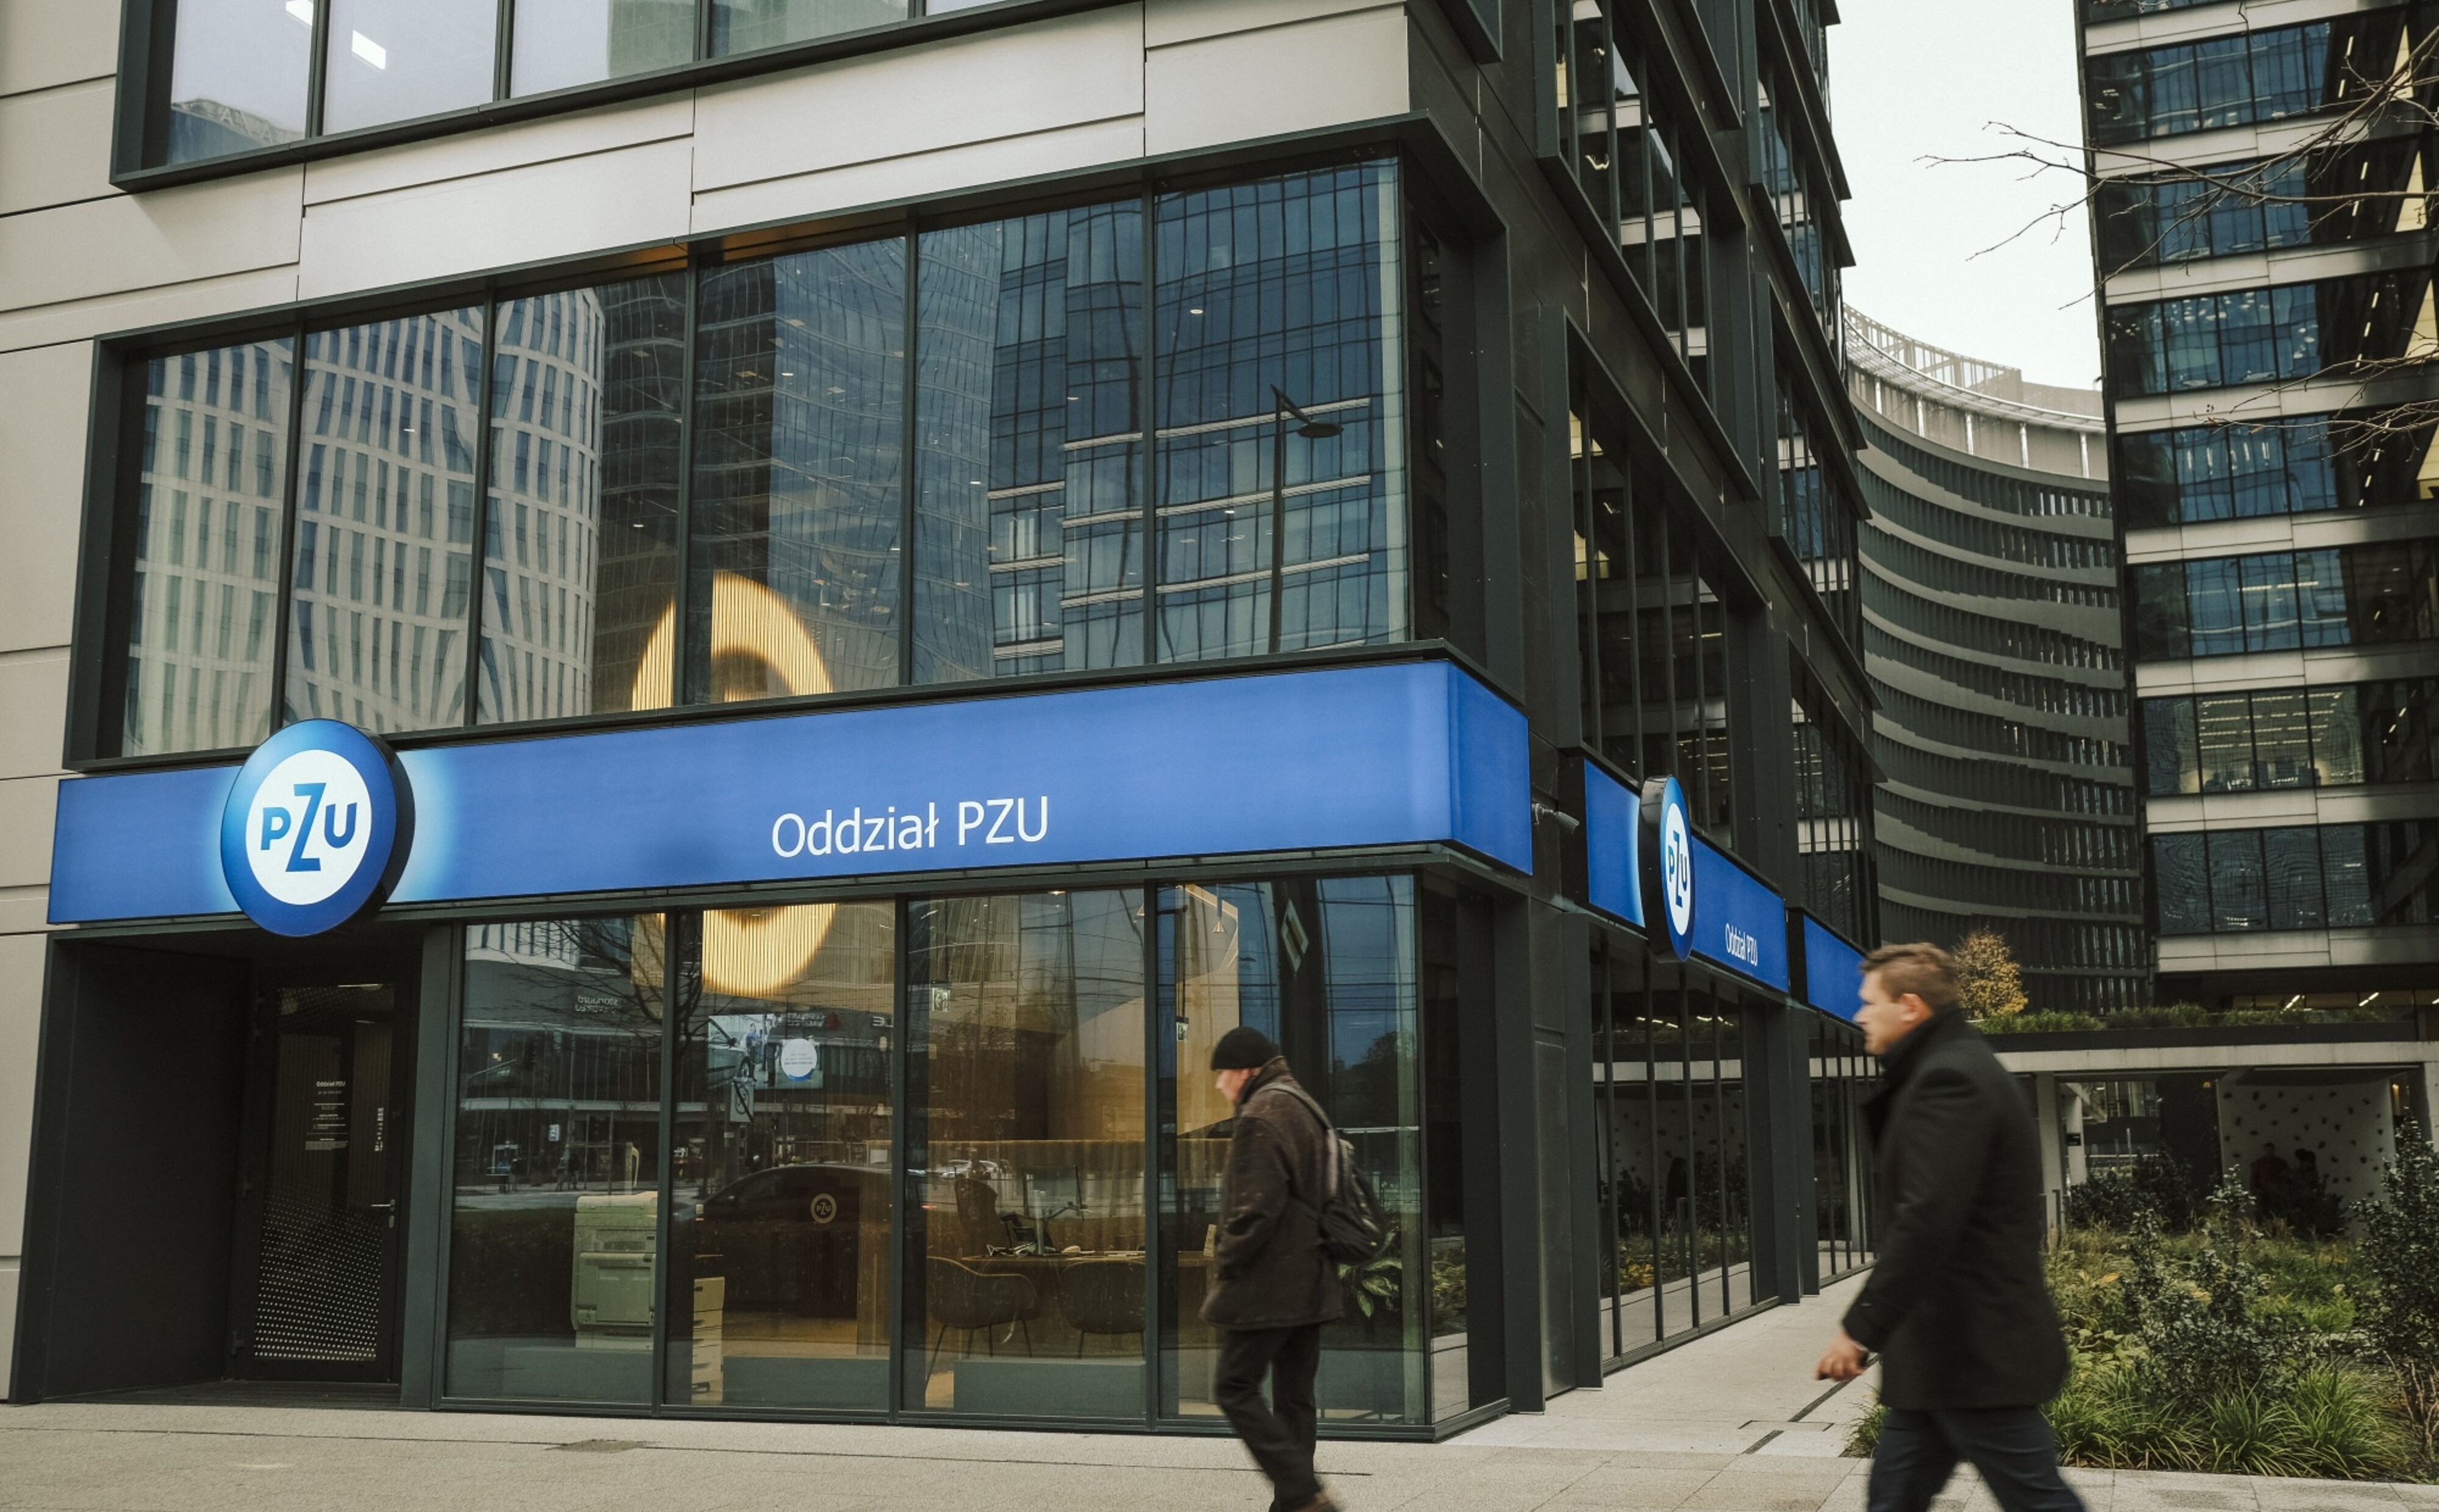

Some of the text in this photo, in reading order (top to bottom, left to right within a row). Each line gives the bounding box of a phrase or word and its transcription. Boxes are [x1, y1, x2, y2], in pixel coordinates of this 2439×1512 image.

[260, 781, 357, 873] PZU
[771, 795, 1049, 858] Oddział PZU
[1668, 830, 1687, 908] PZU
[1725, 922, 1758, 967] Oddział PZU
[816, 1202, 831, 1216] PZU
